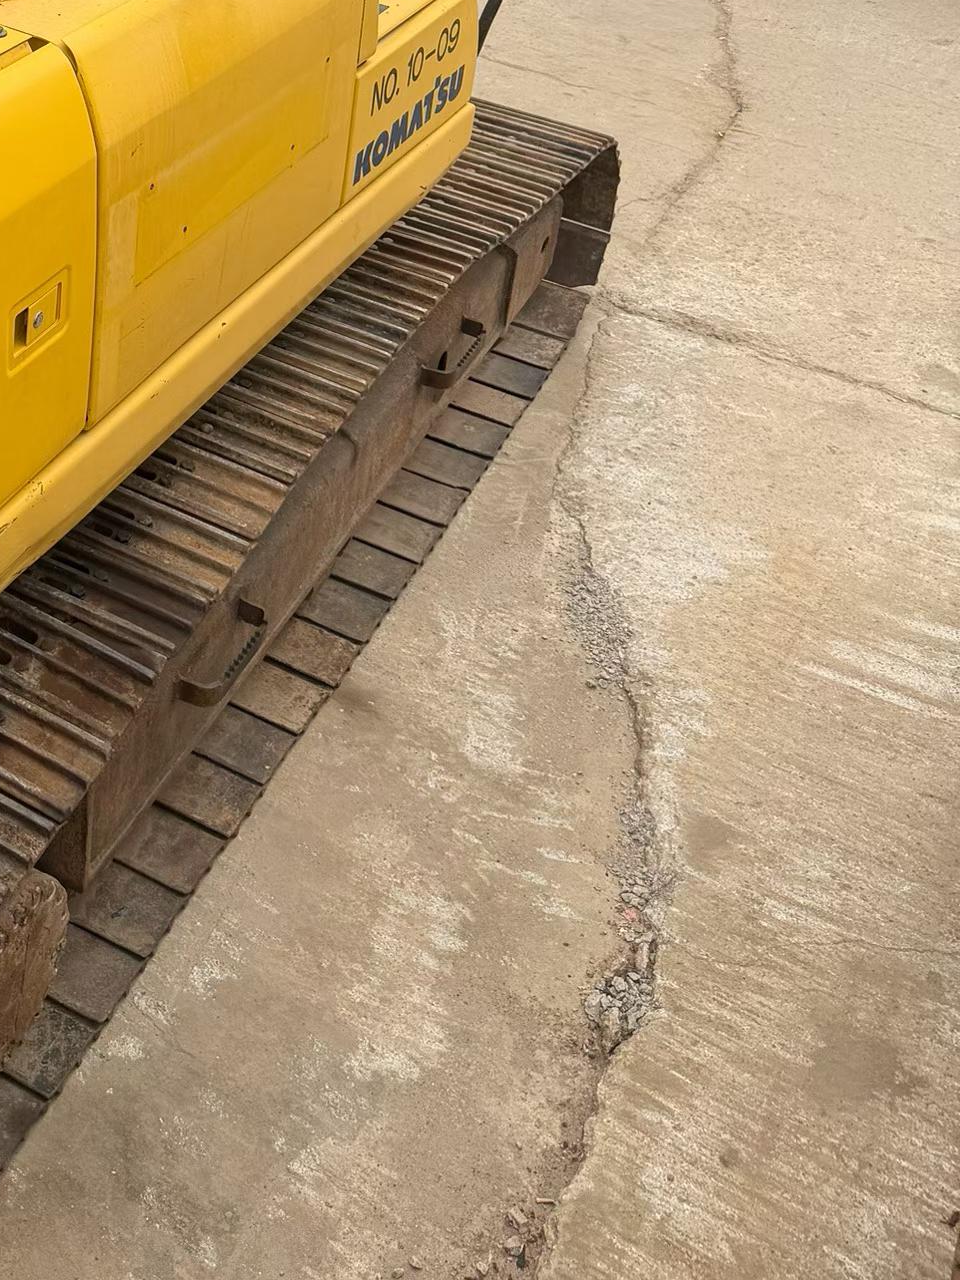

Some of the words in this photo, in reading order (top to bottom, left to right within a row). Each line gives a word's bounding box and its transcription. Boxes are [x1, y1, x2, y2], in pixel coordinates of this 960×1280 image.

[370, 67, 400, 117] NO.
[407, 18, 461, 87] 10-09
[352, 64, 466, 187] KOMATSU
